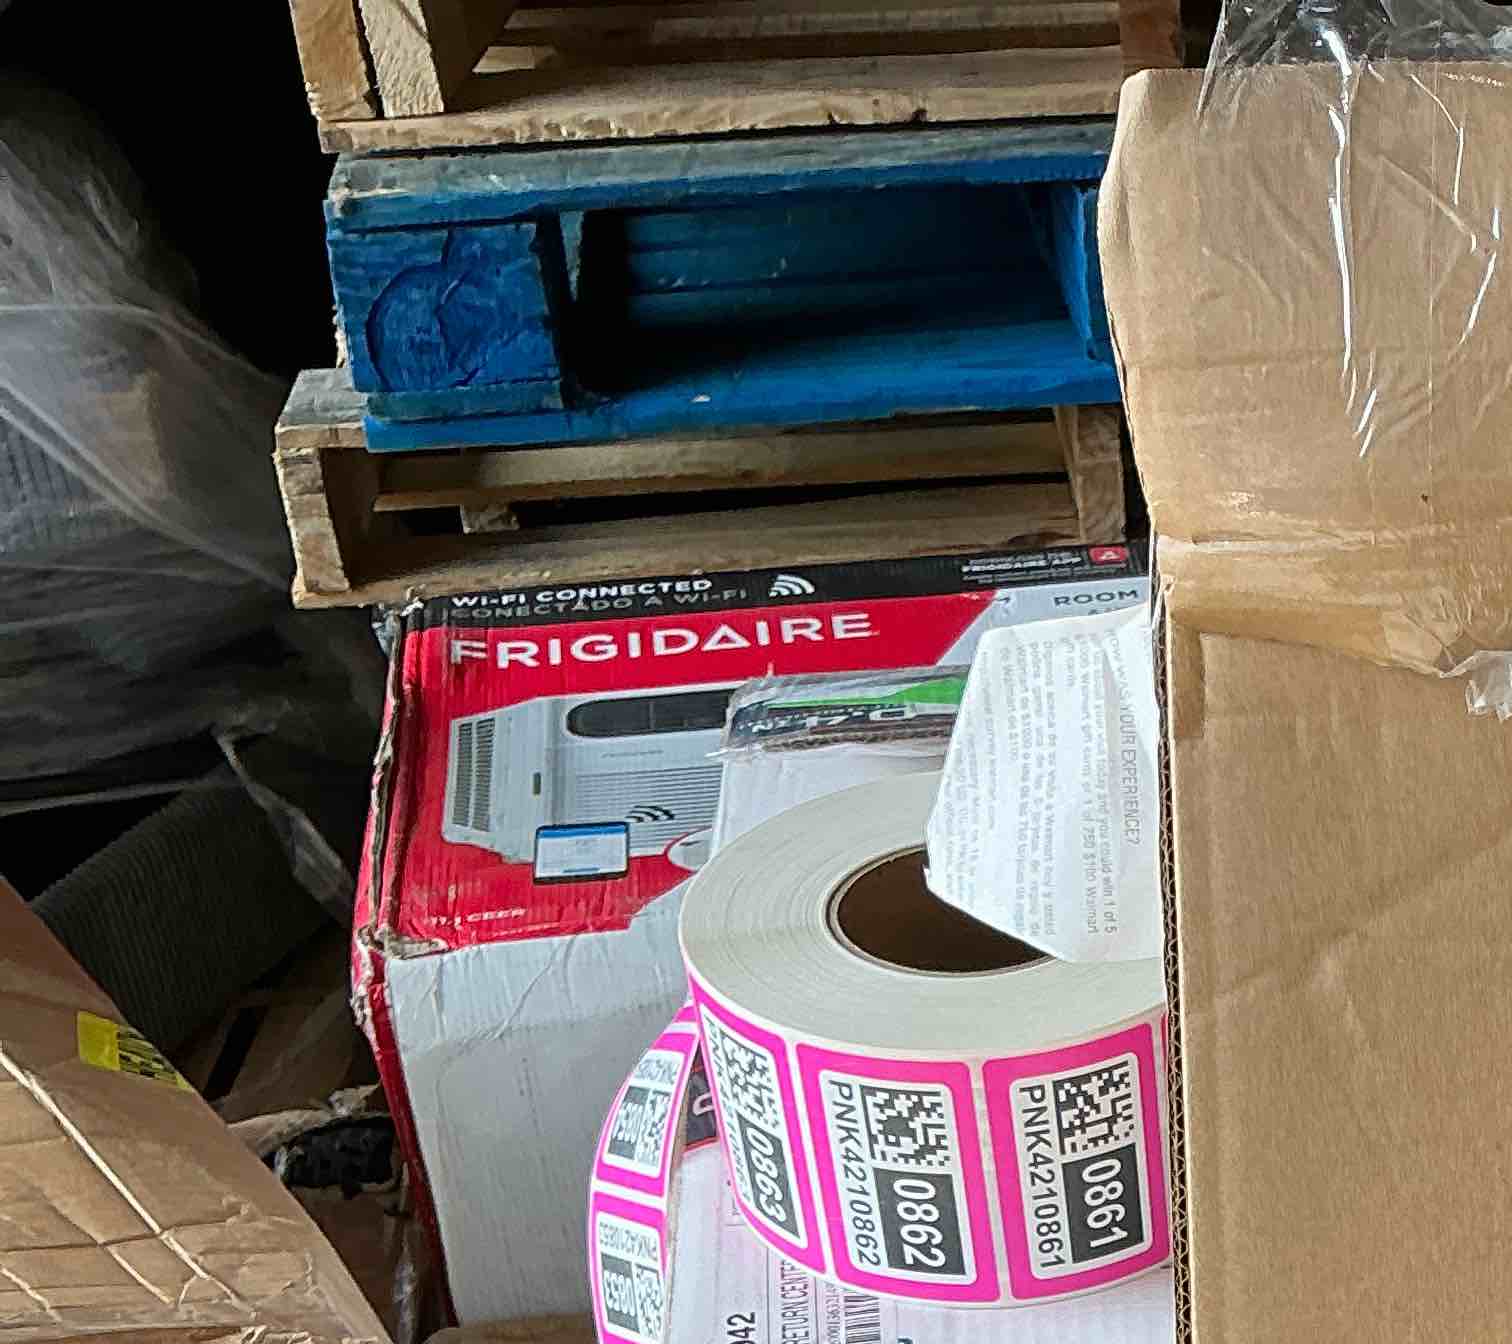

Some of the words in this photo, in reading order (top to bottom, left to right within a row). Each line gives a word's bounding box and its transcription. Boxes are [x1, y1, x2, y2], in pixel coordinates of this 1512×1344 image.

[452, 590, 530, 610] WI-FI
[537, 577, 713, 604] CONNECTED
[1053, 588, 1140, 607] ROOM
[450, 613, 876, 670] FRIGIDAIRE
[1119, 704, 1137, 744] YOUR
[1121, 749, 1141, 846] EXPERIENCE?
[748, 1127, 786, 1223] 0863
[828, 1079, 881, 1267] PNK4210862
[1018, 1084, 1064, 1270] PNK4210861
[1080, 1158, 1129, 1249] 0861
[893, 1177, 946, 1269] 0862
